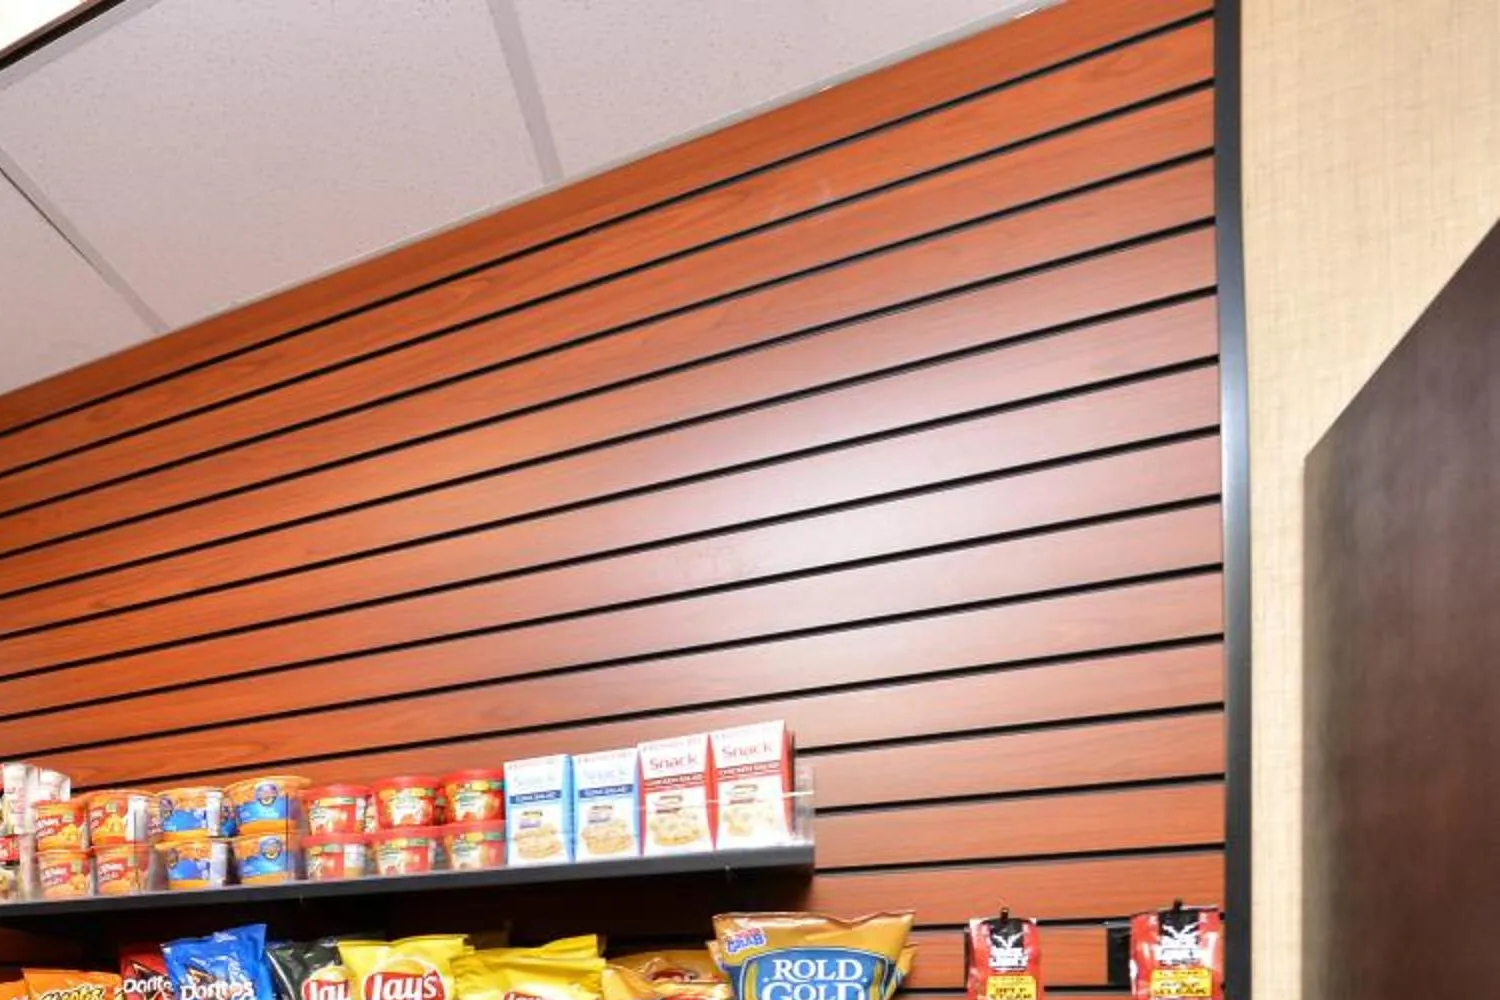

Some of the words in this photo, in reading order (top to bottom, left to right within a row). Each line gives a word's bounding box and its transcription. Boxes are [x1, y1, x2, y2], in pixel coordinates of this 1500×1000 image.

[649, 753, 698, 770] Snack
[772, 958, 864, 983] ROLD
[123, 975, 173, 994] Dorito
